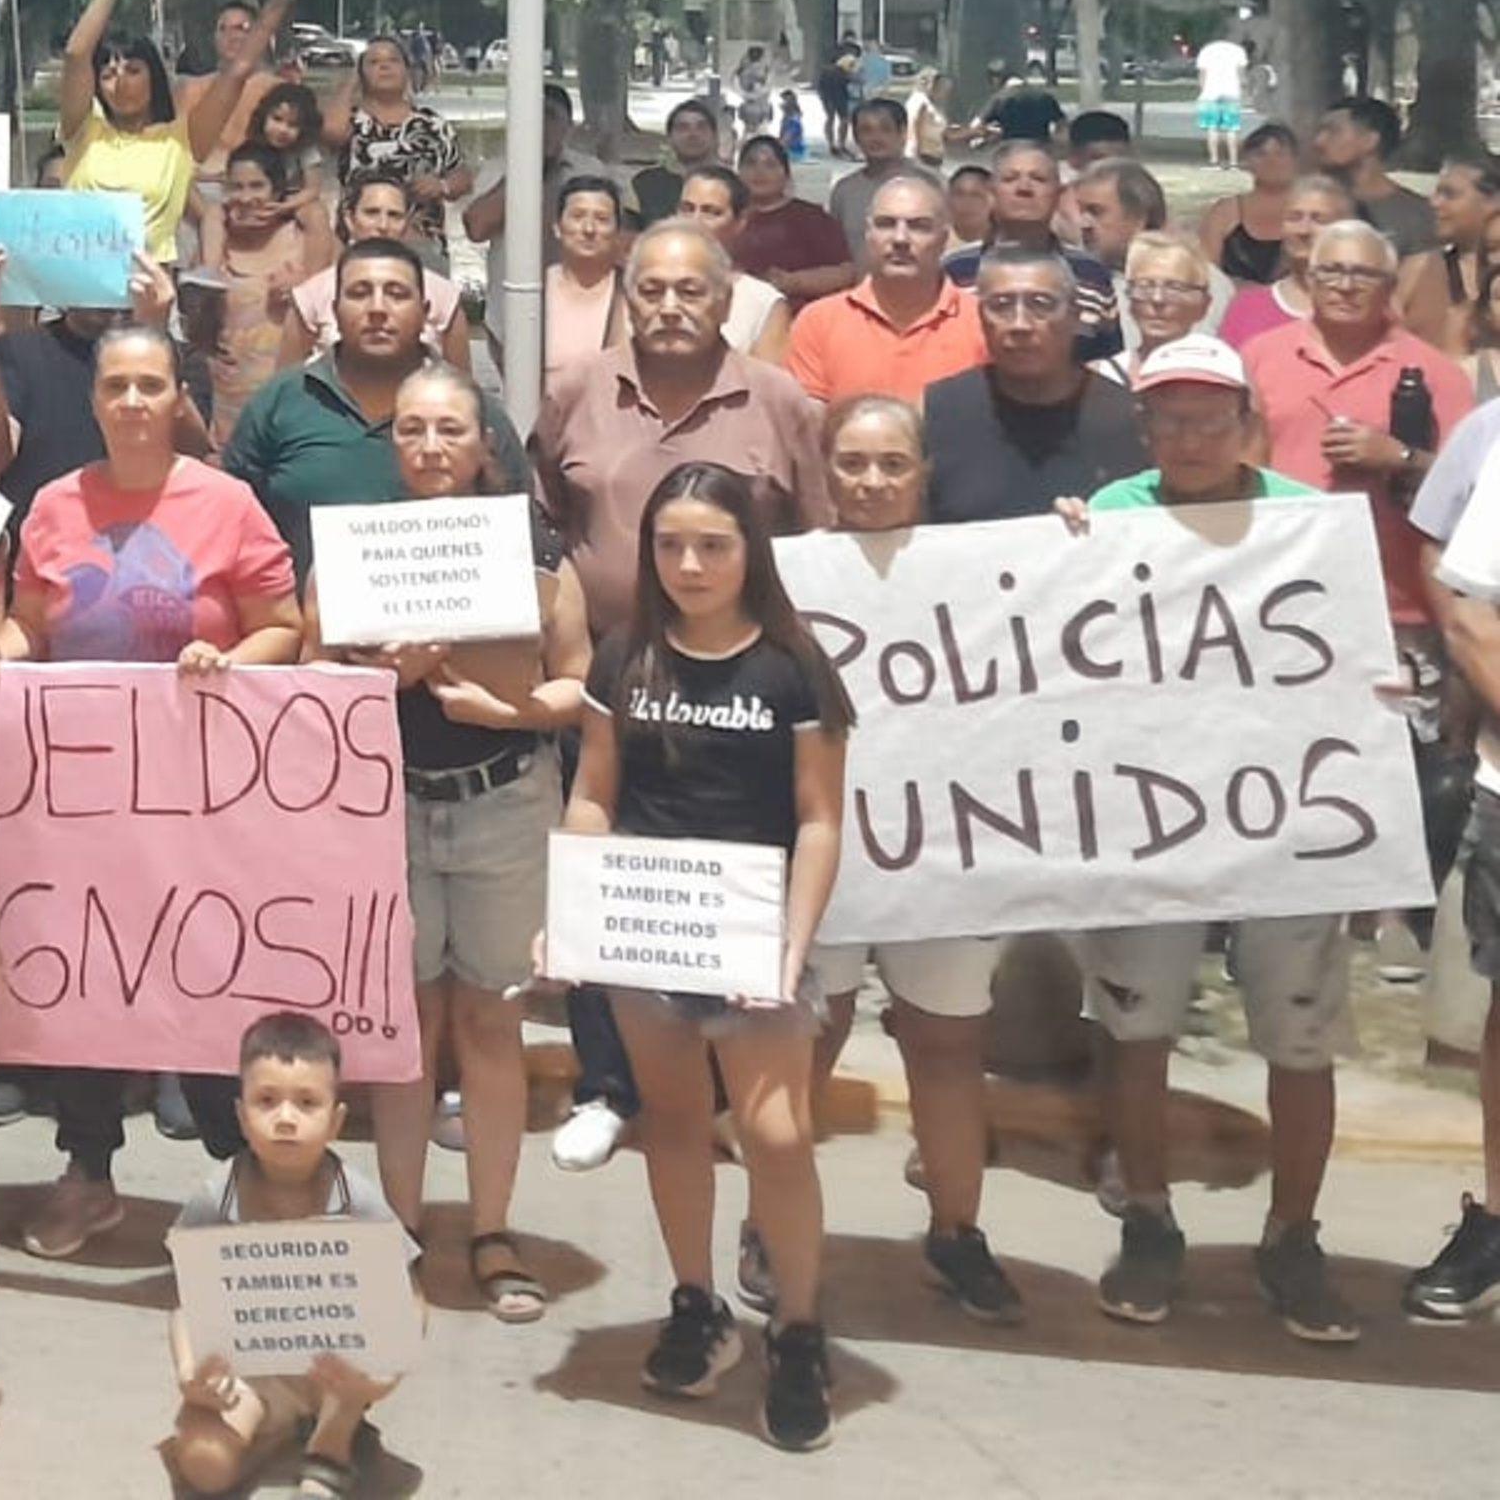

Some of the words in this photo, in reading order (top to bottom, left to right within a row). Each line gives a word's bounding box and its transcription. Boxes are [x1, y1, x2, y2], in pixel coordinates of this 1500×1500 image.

[349, 518, 421, 536] SUELDOS
[427, 513, 490, 531] DIGNOS
[362, 547, 407, 562] PARA
[410, 541, 483, 561] QUIENES
[369, 567, 481, 588] SOSTENEMOS
[383, 601, 400, 615] EL
[406, 597, 472, 614] ESTADO
[602, 853, 722, 877] SEGURIDAD
[600, 884, 692, 906] TAMBIEN
[699, 891, 725, 908] ES
[604, 915, 718, 939] DERECHOS
[600, 946, 722, 970] LABORALES
[220, 1240, 349, 1261] SEGURIDAD
[221, 1274, 323, 1292] TAMBIEN
[330, 1273, 359, 1289] ES
[234, 1304, 357, 1325] DERECHOS
[234, 1334, 366, 1352] LABORALES
